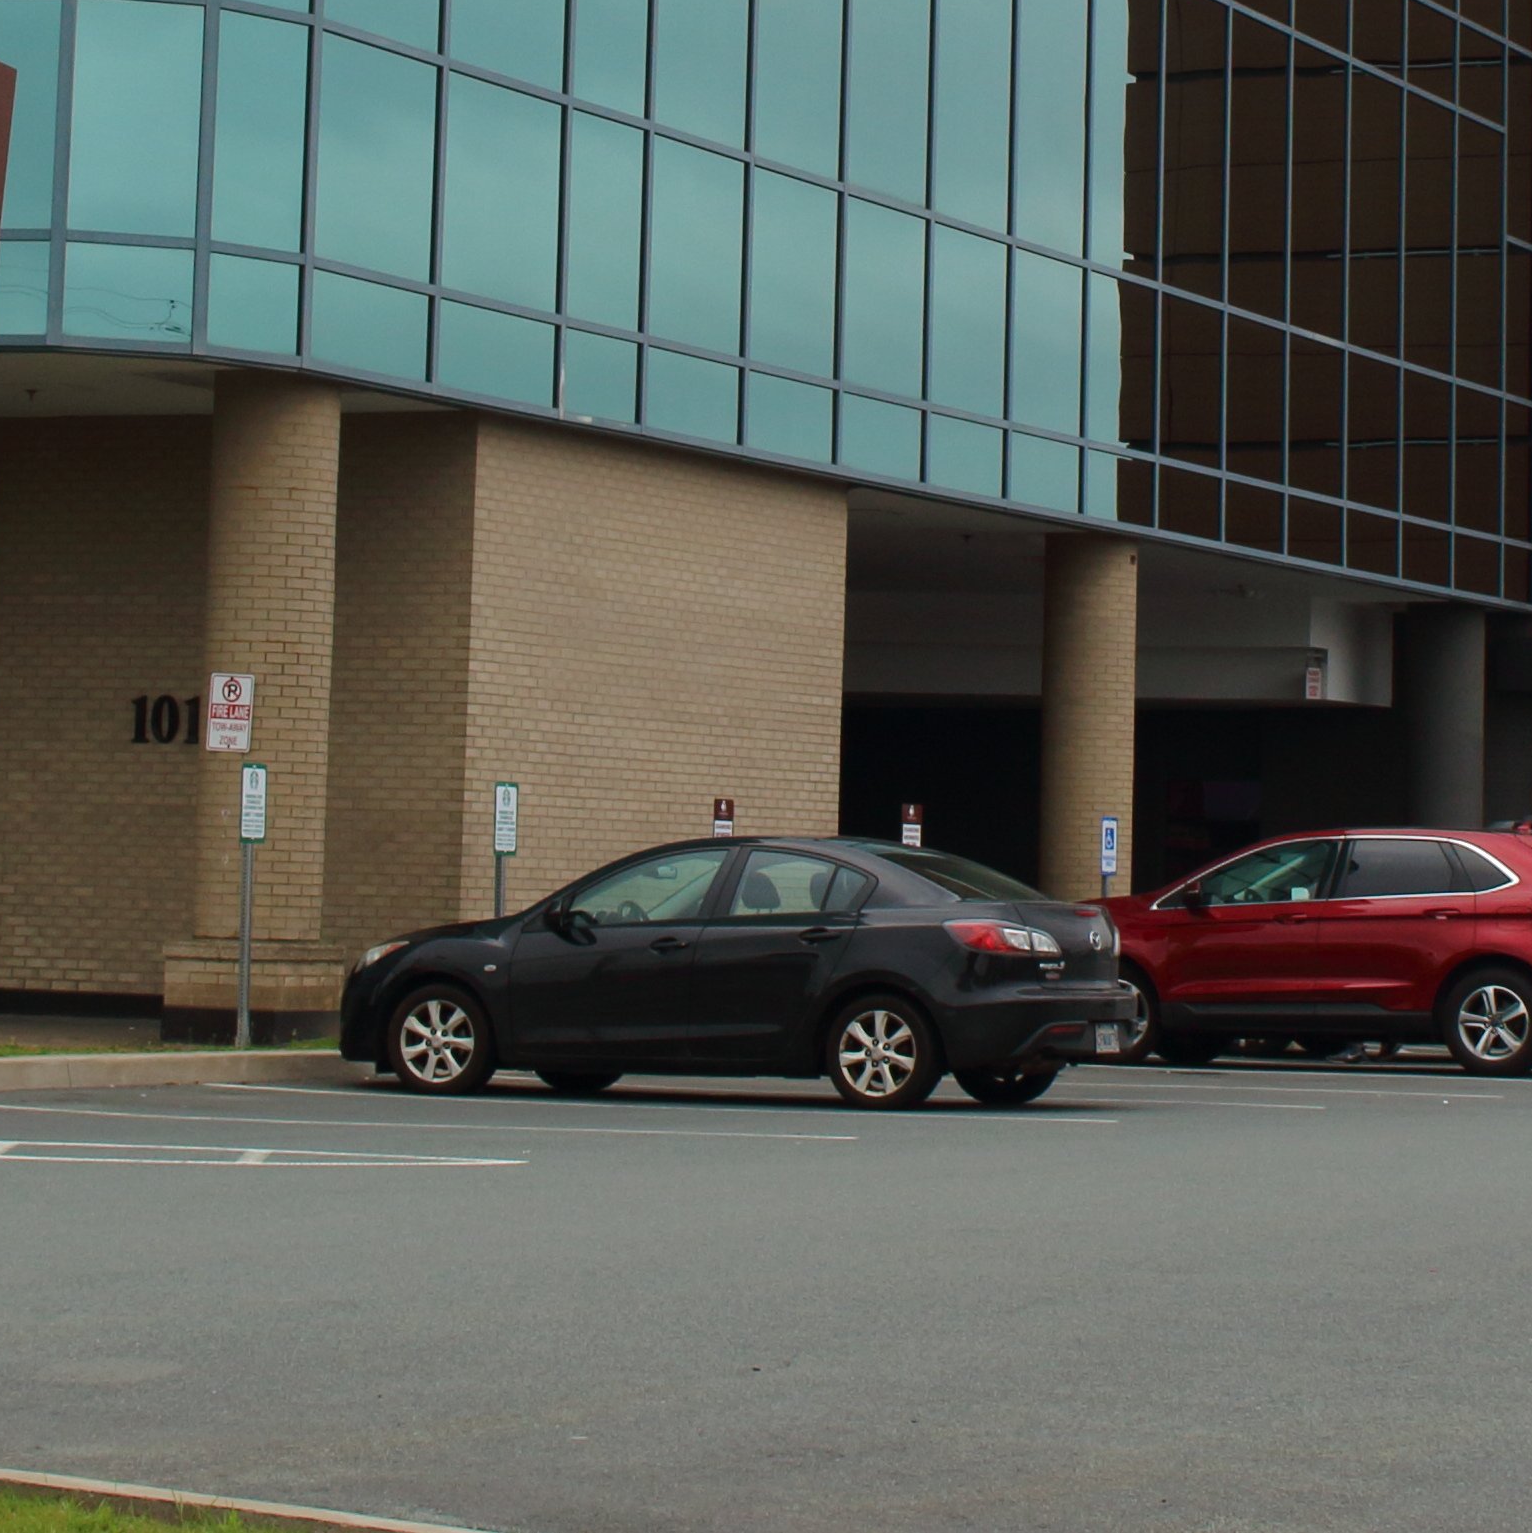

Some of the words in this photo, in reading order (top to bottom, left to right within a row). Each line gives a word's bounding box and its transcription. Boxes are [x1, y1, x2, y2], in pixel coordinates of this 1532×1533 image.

[211, 704, 229, 719] FIRE
[229, 705, 250, 720] LANE
[219, 735, 238, 746] ZONE
